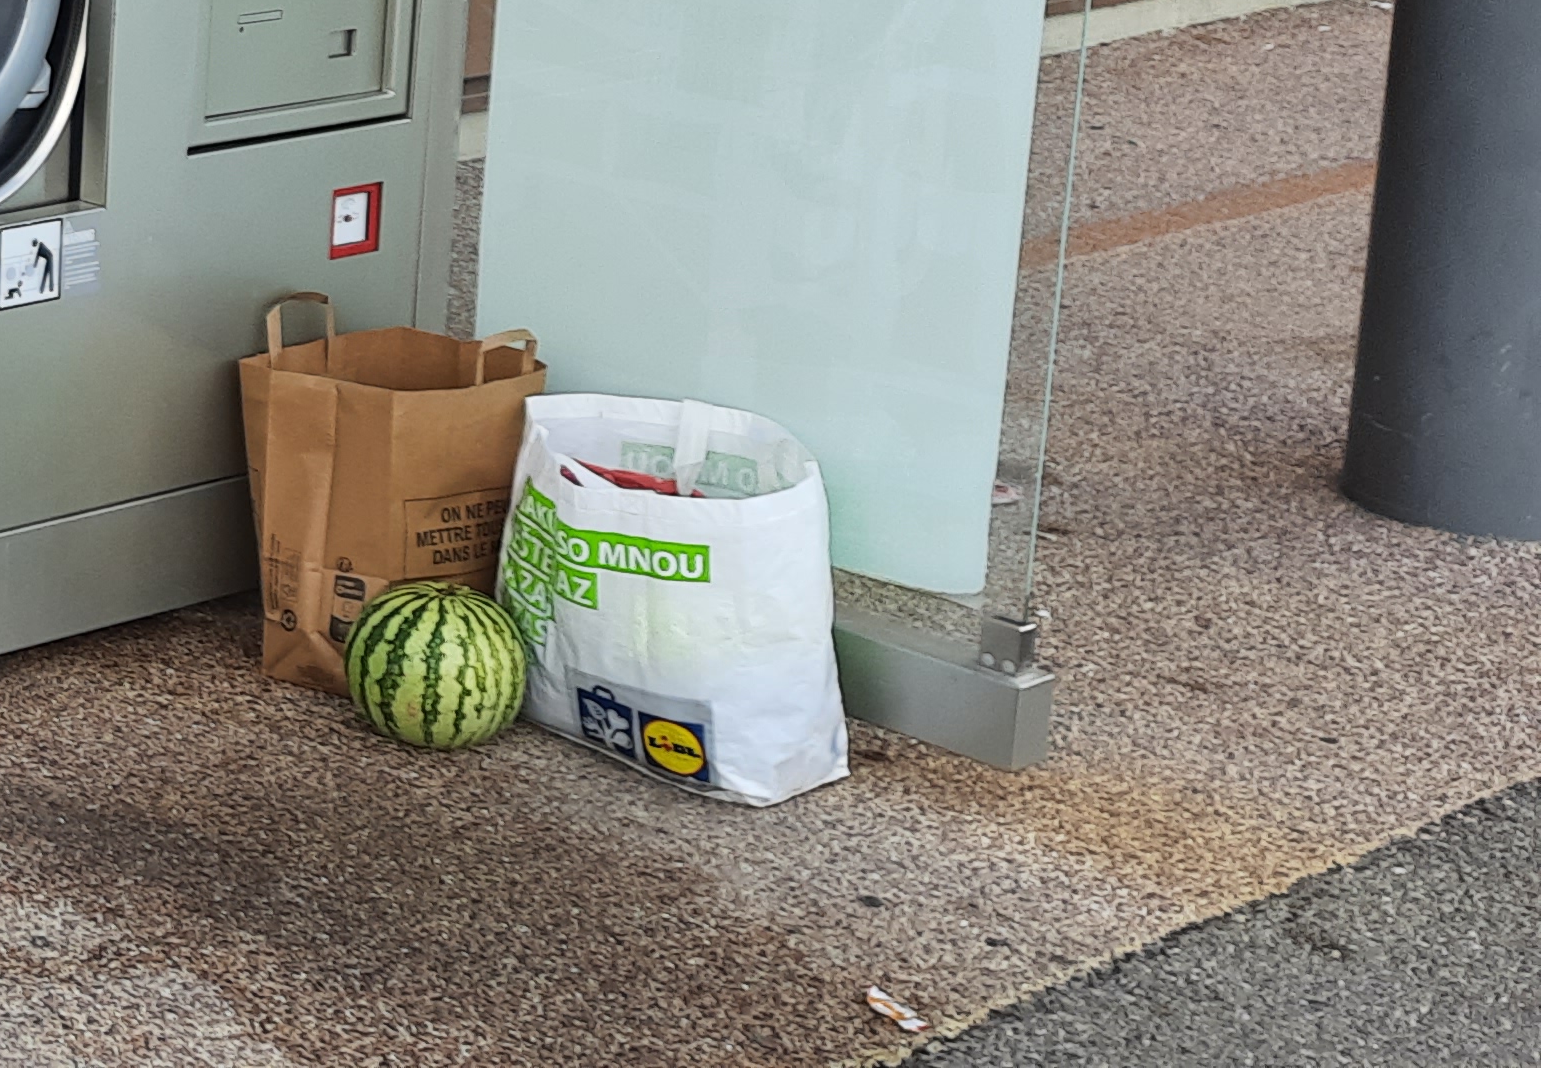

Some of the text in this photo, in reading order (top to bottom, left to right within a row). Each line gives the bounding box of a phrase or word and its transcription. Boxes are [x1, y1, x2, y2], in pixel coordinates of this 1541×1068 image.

[441, 505, 461, 524] ON
[465, 501, 484, 521] NE
[416, 525, 473, 548] METTRE
[433, 545, 470, 565] DANS
[473, 542, 487, 560] LE
[556, 531, 590, 562] SO
[598, 541, 704, 579] MNOU
